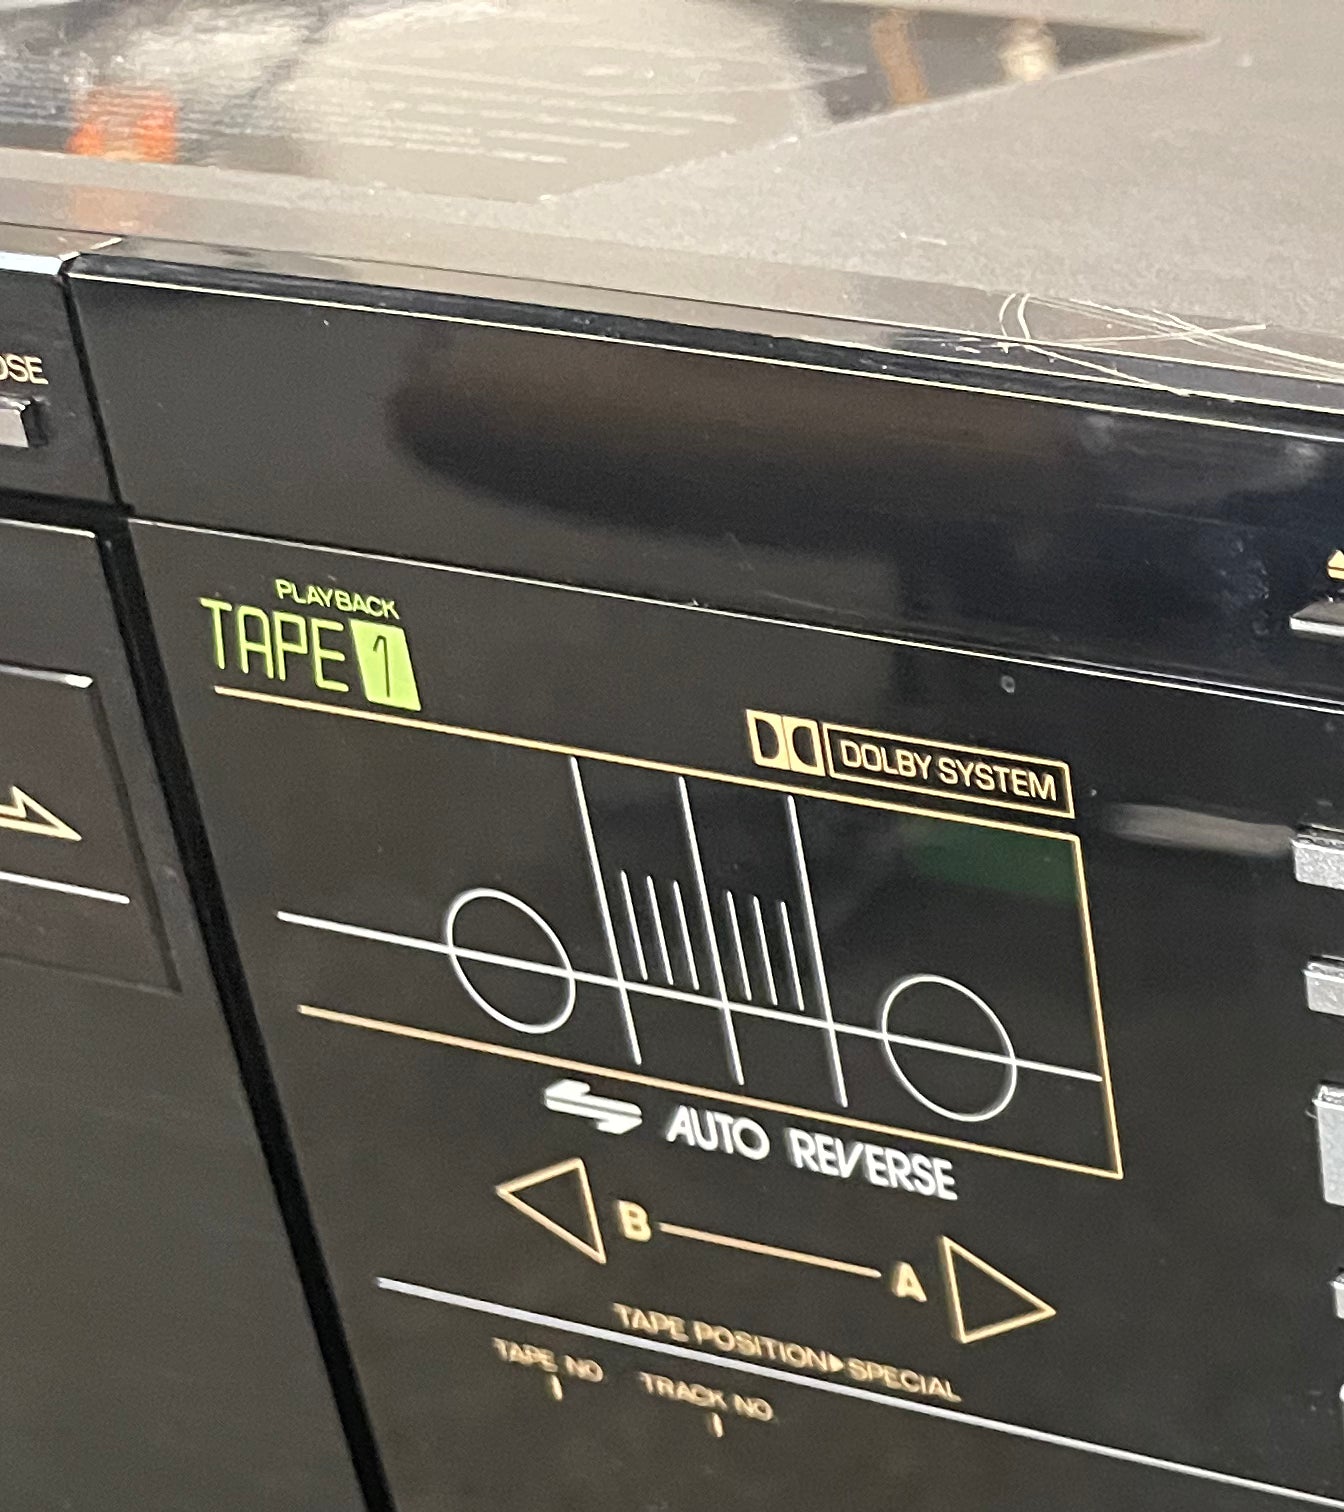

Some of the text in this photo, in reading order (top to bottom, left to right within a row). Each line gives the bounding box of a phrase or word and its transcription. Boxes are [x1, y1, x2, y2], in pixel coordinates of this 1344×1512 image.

[274, 578, 400, 620] PLAYBACK
[199, 596, 350, 693] TAPE
[838, 738, 1058, 802] DOLBY SYSTEM
[664, 1105, 959, 1201] AUTO REVERSE
[616, 1200, 653, 1243] B
[891, 1260, 928, 1303] A
[491, 1336, 559, 1373] TAPE
[610, 1301, 964, 1403] TAPE POSITION SPECIAL
[637, 1370, 729, 1412] TRACK
